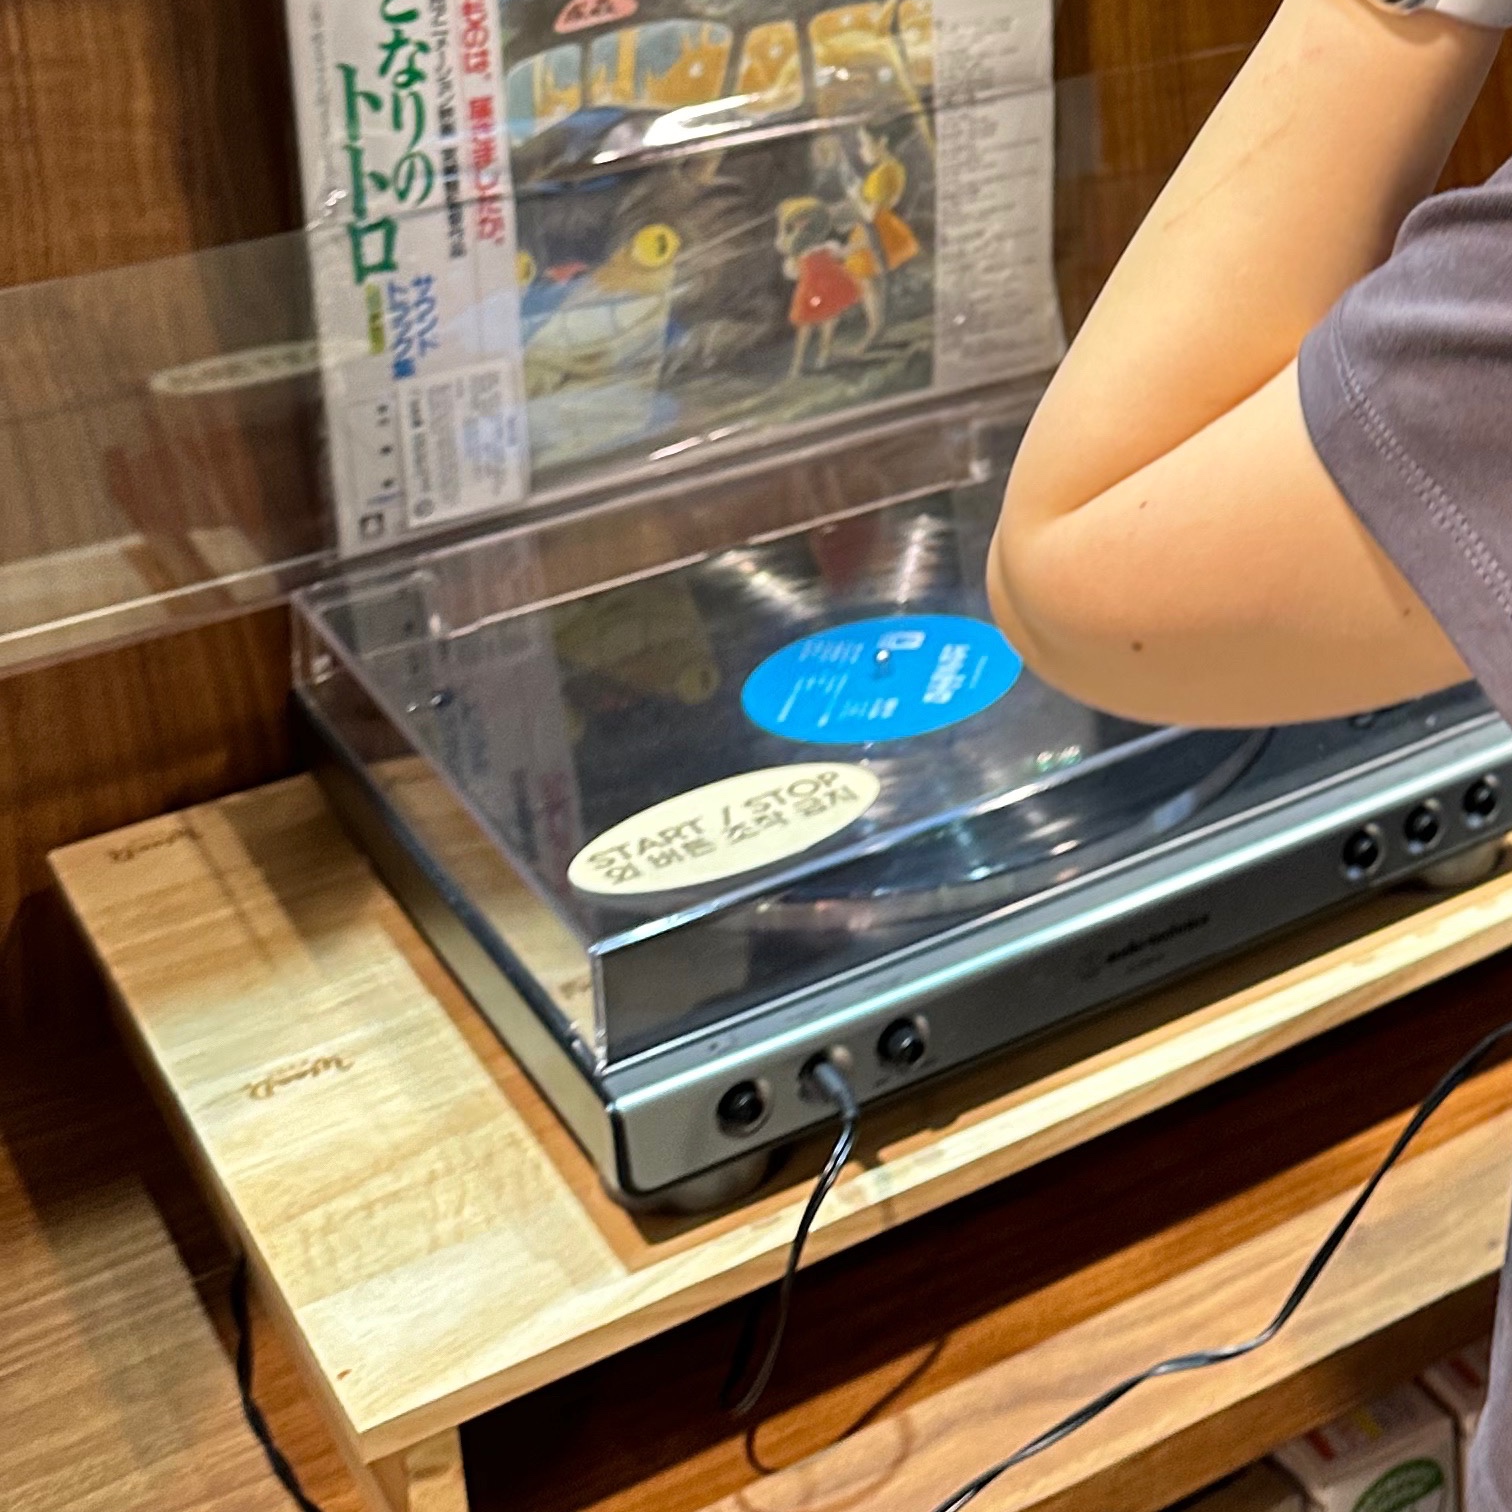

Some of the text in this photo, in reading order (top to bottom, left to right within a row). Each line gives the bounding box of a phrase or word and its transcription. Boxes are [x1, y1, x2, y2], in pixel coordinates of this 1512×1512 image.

[335, 63, 398, 284] トトロ
[587, 815, 704, 870] START
[744, 771, 840, 814] STOP
[605, 785, 860, 885] 외 버튼 조작 금지
